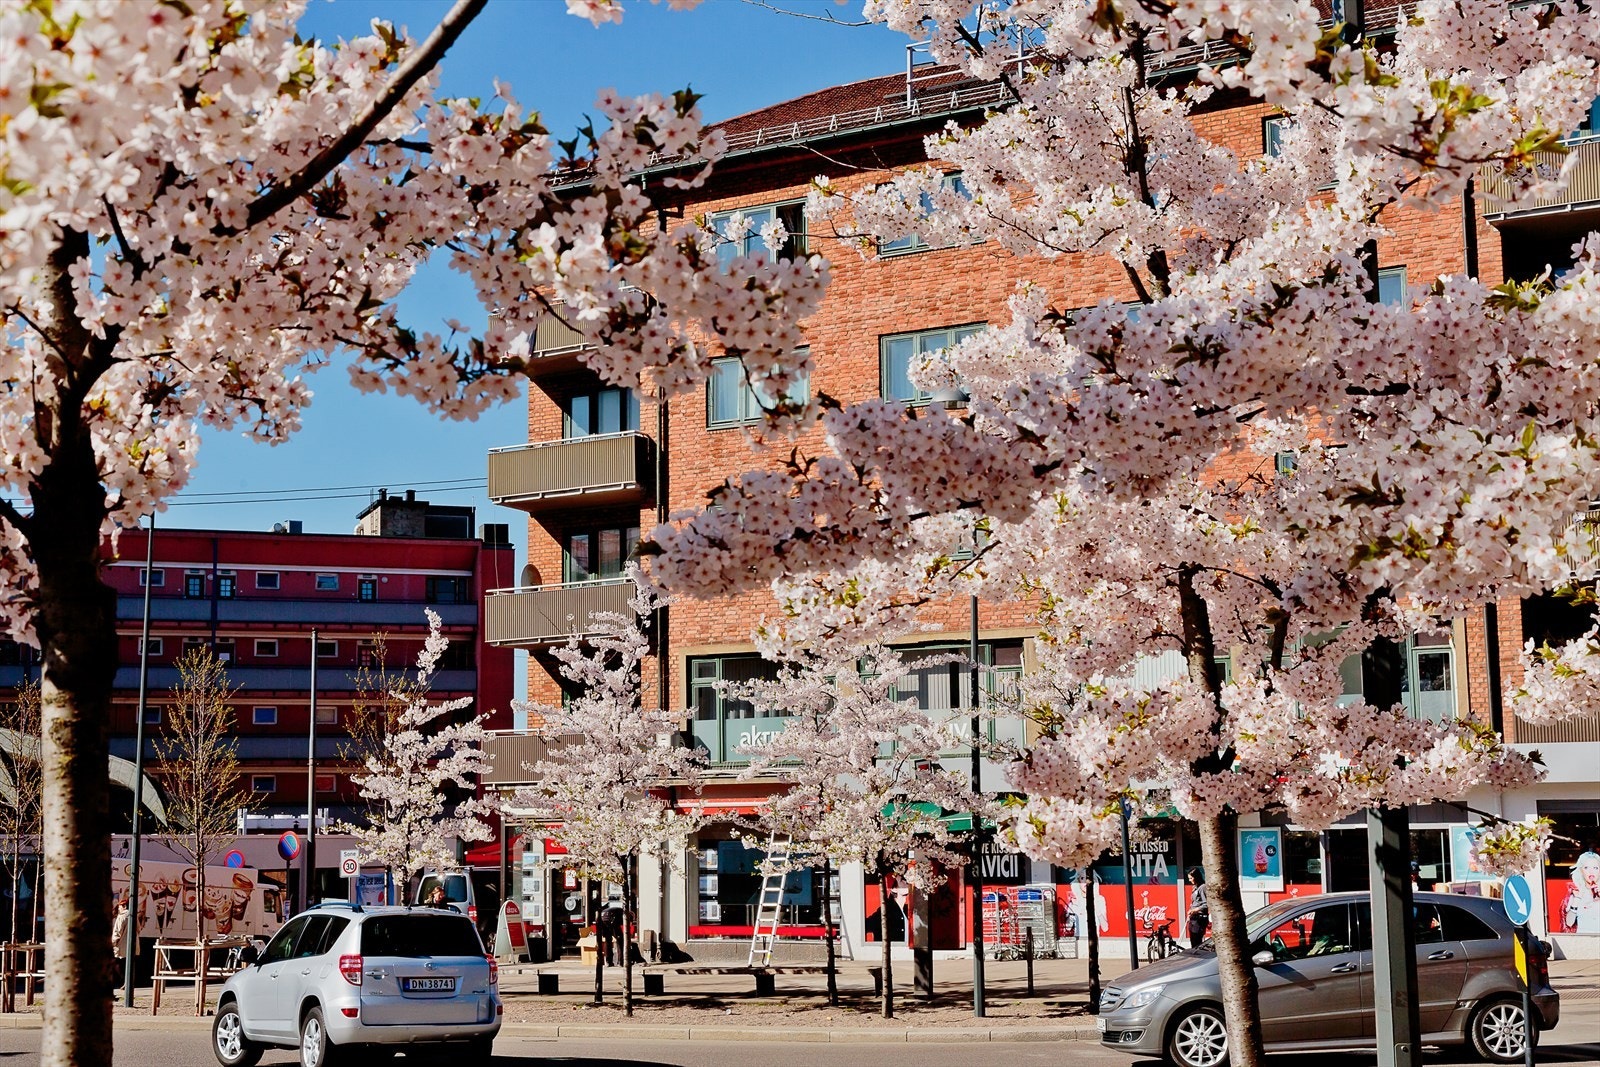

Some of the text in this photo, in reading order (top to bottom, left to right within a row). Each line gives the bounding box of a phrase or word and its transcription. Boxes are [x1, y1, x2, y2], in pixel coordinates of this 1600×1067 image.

[1139, 841, 1169, 853] KISSED
[345, 862, 355, 871] 30
[411, 979, 454, 989] DN 38741
